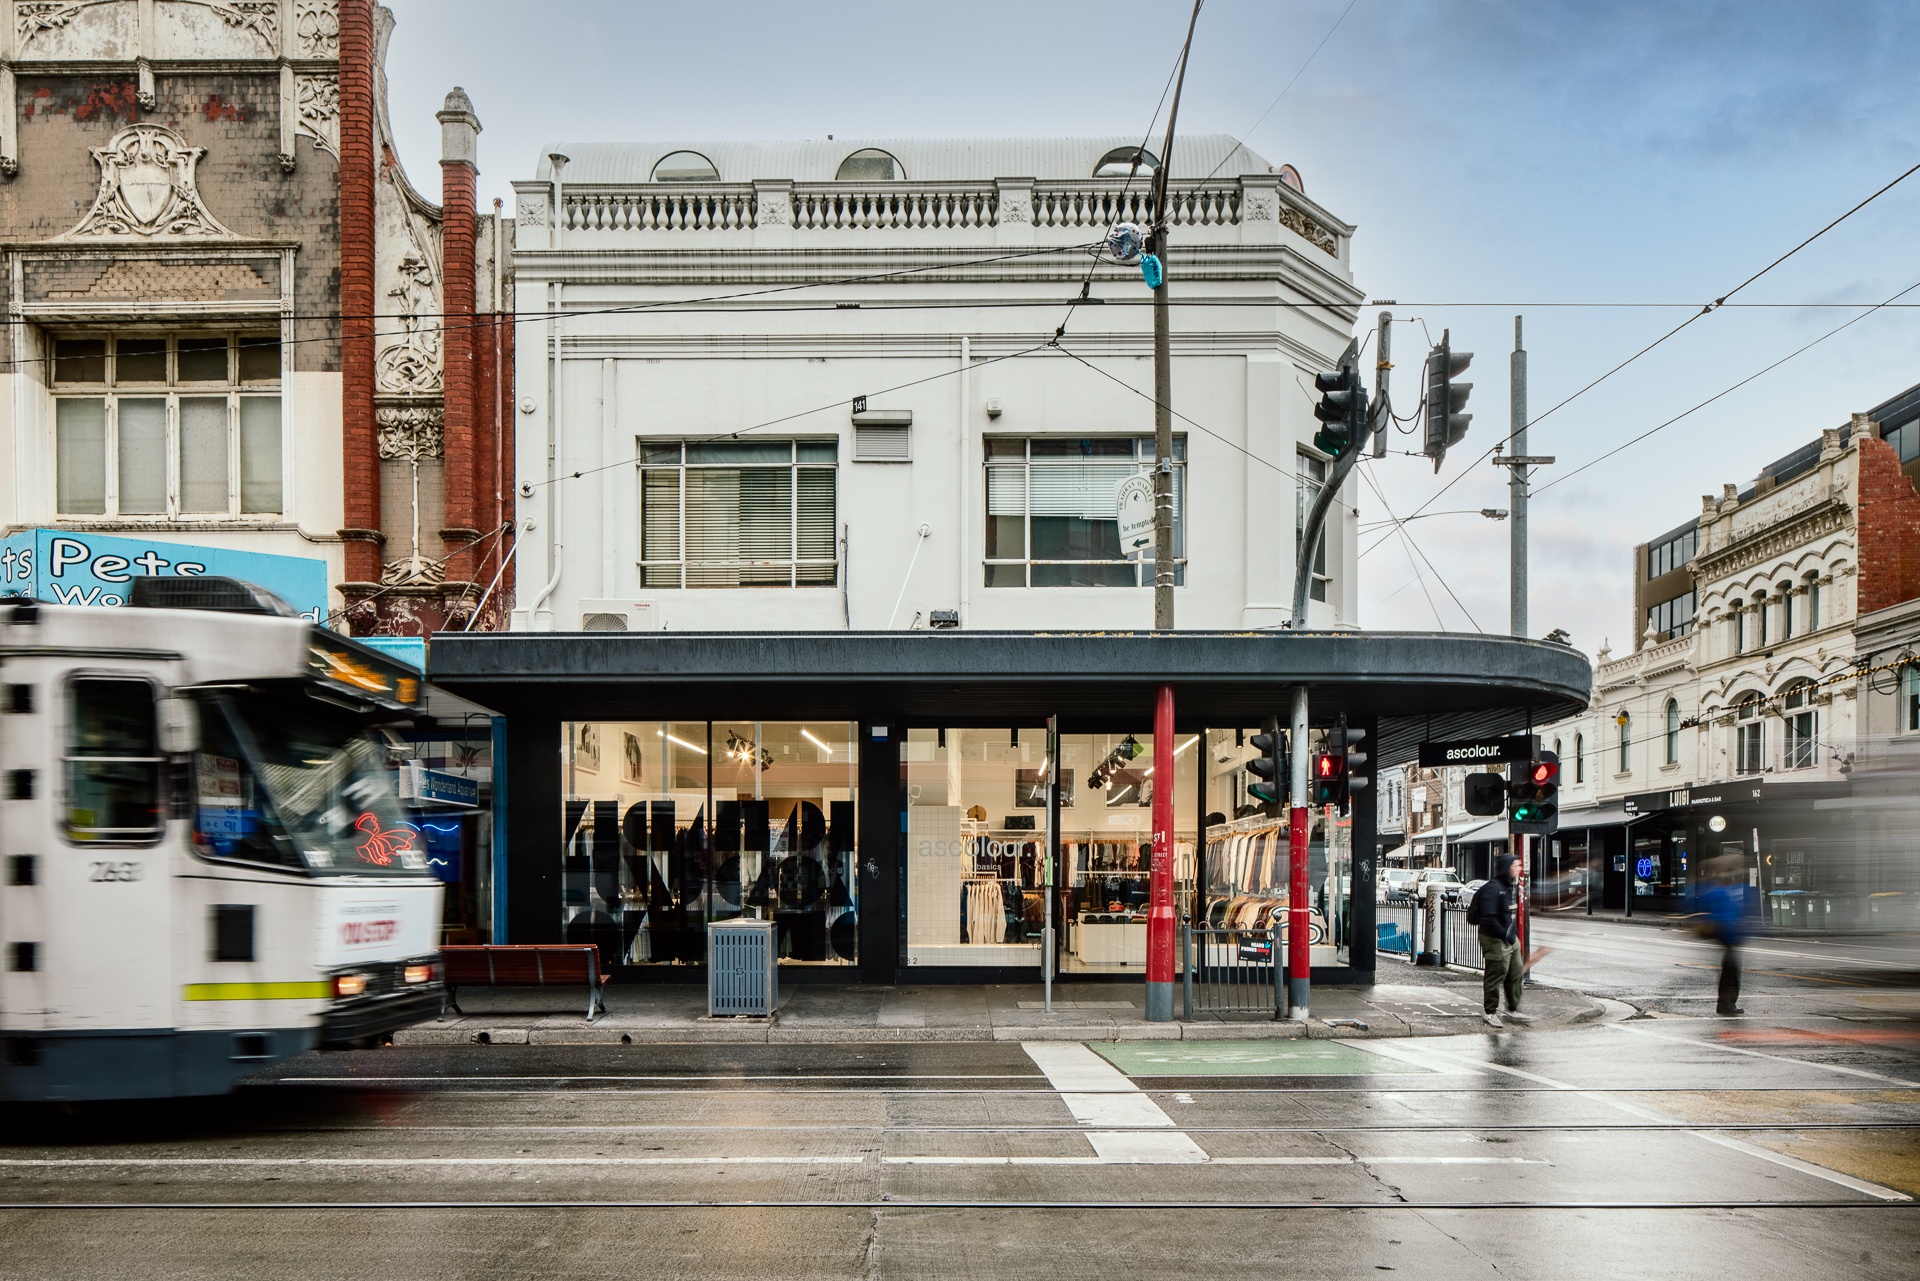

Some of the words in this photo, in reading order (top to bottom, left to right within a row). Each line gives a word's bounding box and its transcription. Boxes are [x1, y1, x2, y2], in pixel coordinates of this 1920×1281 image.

[854, 400, 865, 412] 141
[1119, 482, 1136, 510] PRAHRAN
[1137, 481, 1153, 502] MARKET
[1122, 524, 1130, 532] be
[0, 547, 32, 583] ts
[50, 537, 206, 583] Pets
[1446, 744, 1501, 759] ascolour.
[430, 776, 457, 794] Wonderland
[457, 782, 476, 799] Aquarium
[1752, 789, 1761, 797] 162
[1670, 790, 1690, 807] LUIGI
[918, 836, 1031, 857] ascolour.
